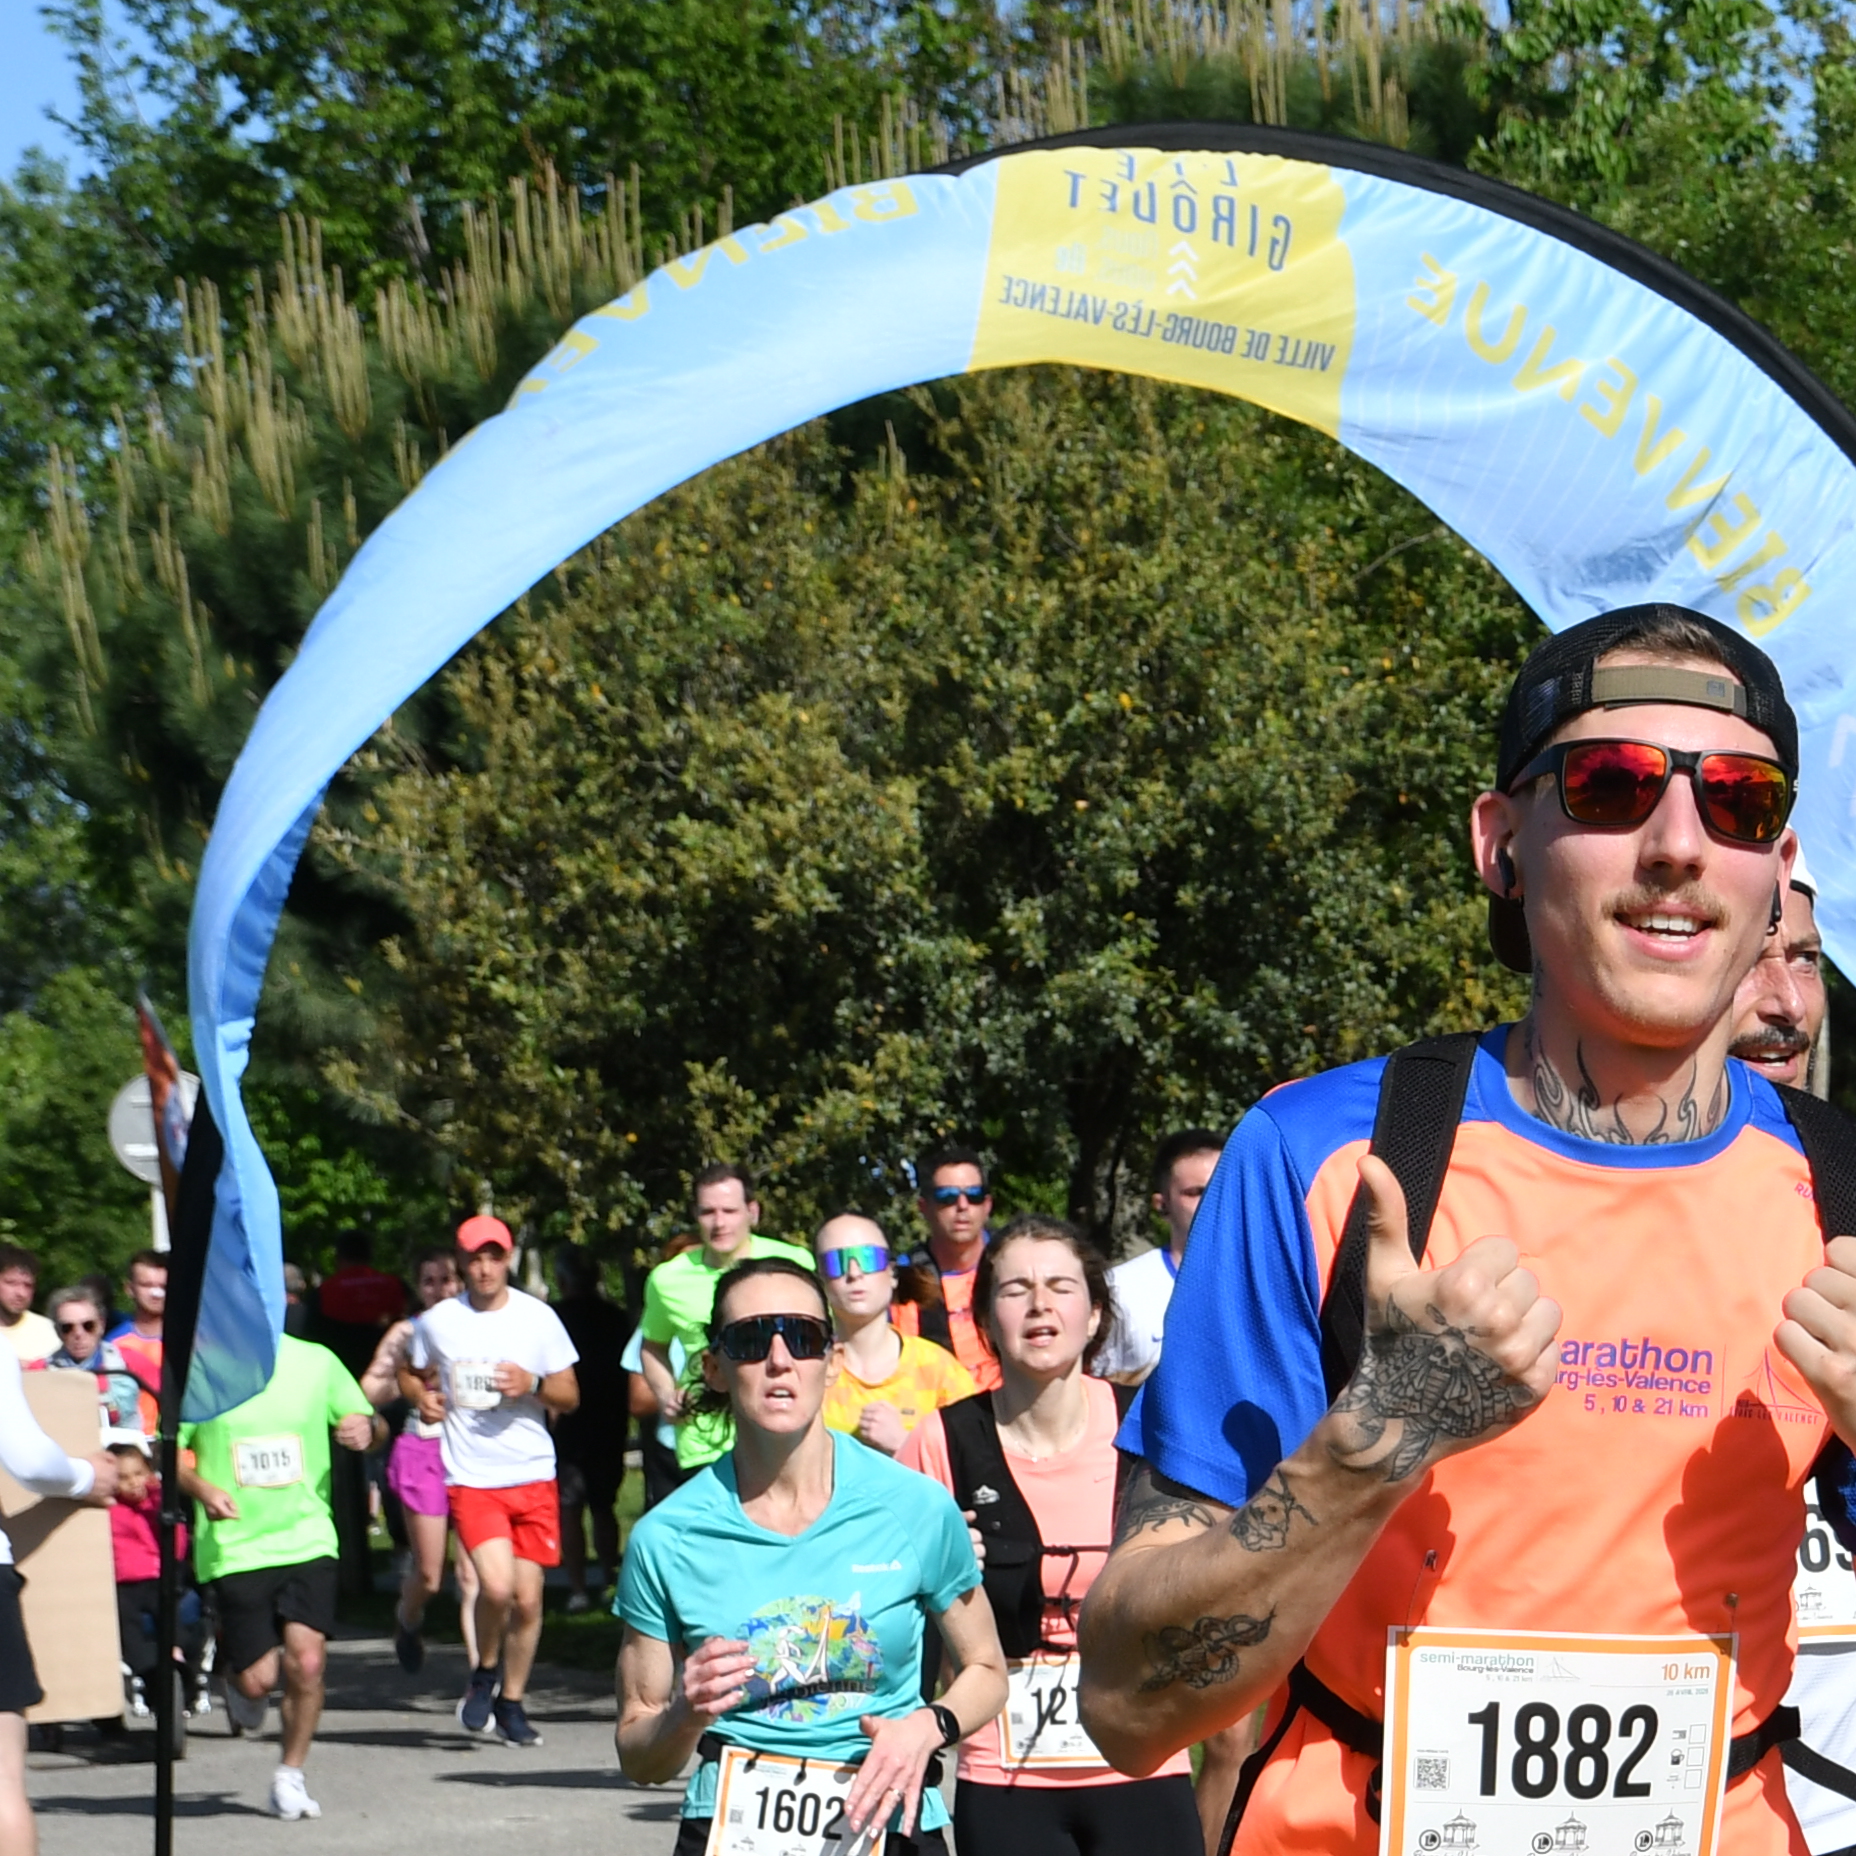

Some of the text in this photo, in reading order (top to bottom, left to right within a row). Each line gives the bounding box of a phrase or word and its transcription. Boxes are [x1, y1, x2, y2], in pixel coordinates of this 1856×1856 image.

[1560, 1336, 1714, 1375] arathon
[1553, 1368, 1711, 1396] rg-lès-Valence
[1612, 1395, 1628, 1413] 10
[1632, 1400, 1646, 1413] &
[1653, 1397, 1674, 1415] 21
[1679, 1398, 1710, 1418] km
[1420, 1651, 1711, 1682] semi-marathon 10 km
[1468, 1701, 1659, 1801] 1882
[755, 1785, 846, 1841] 1602
